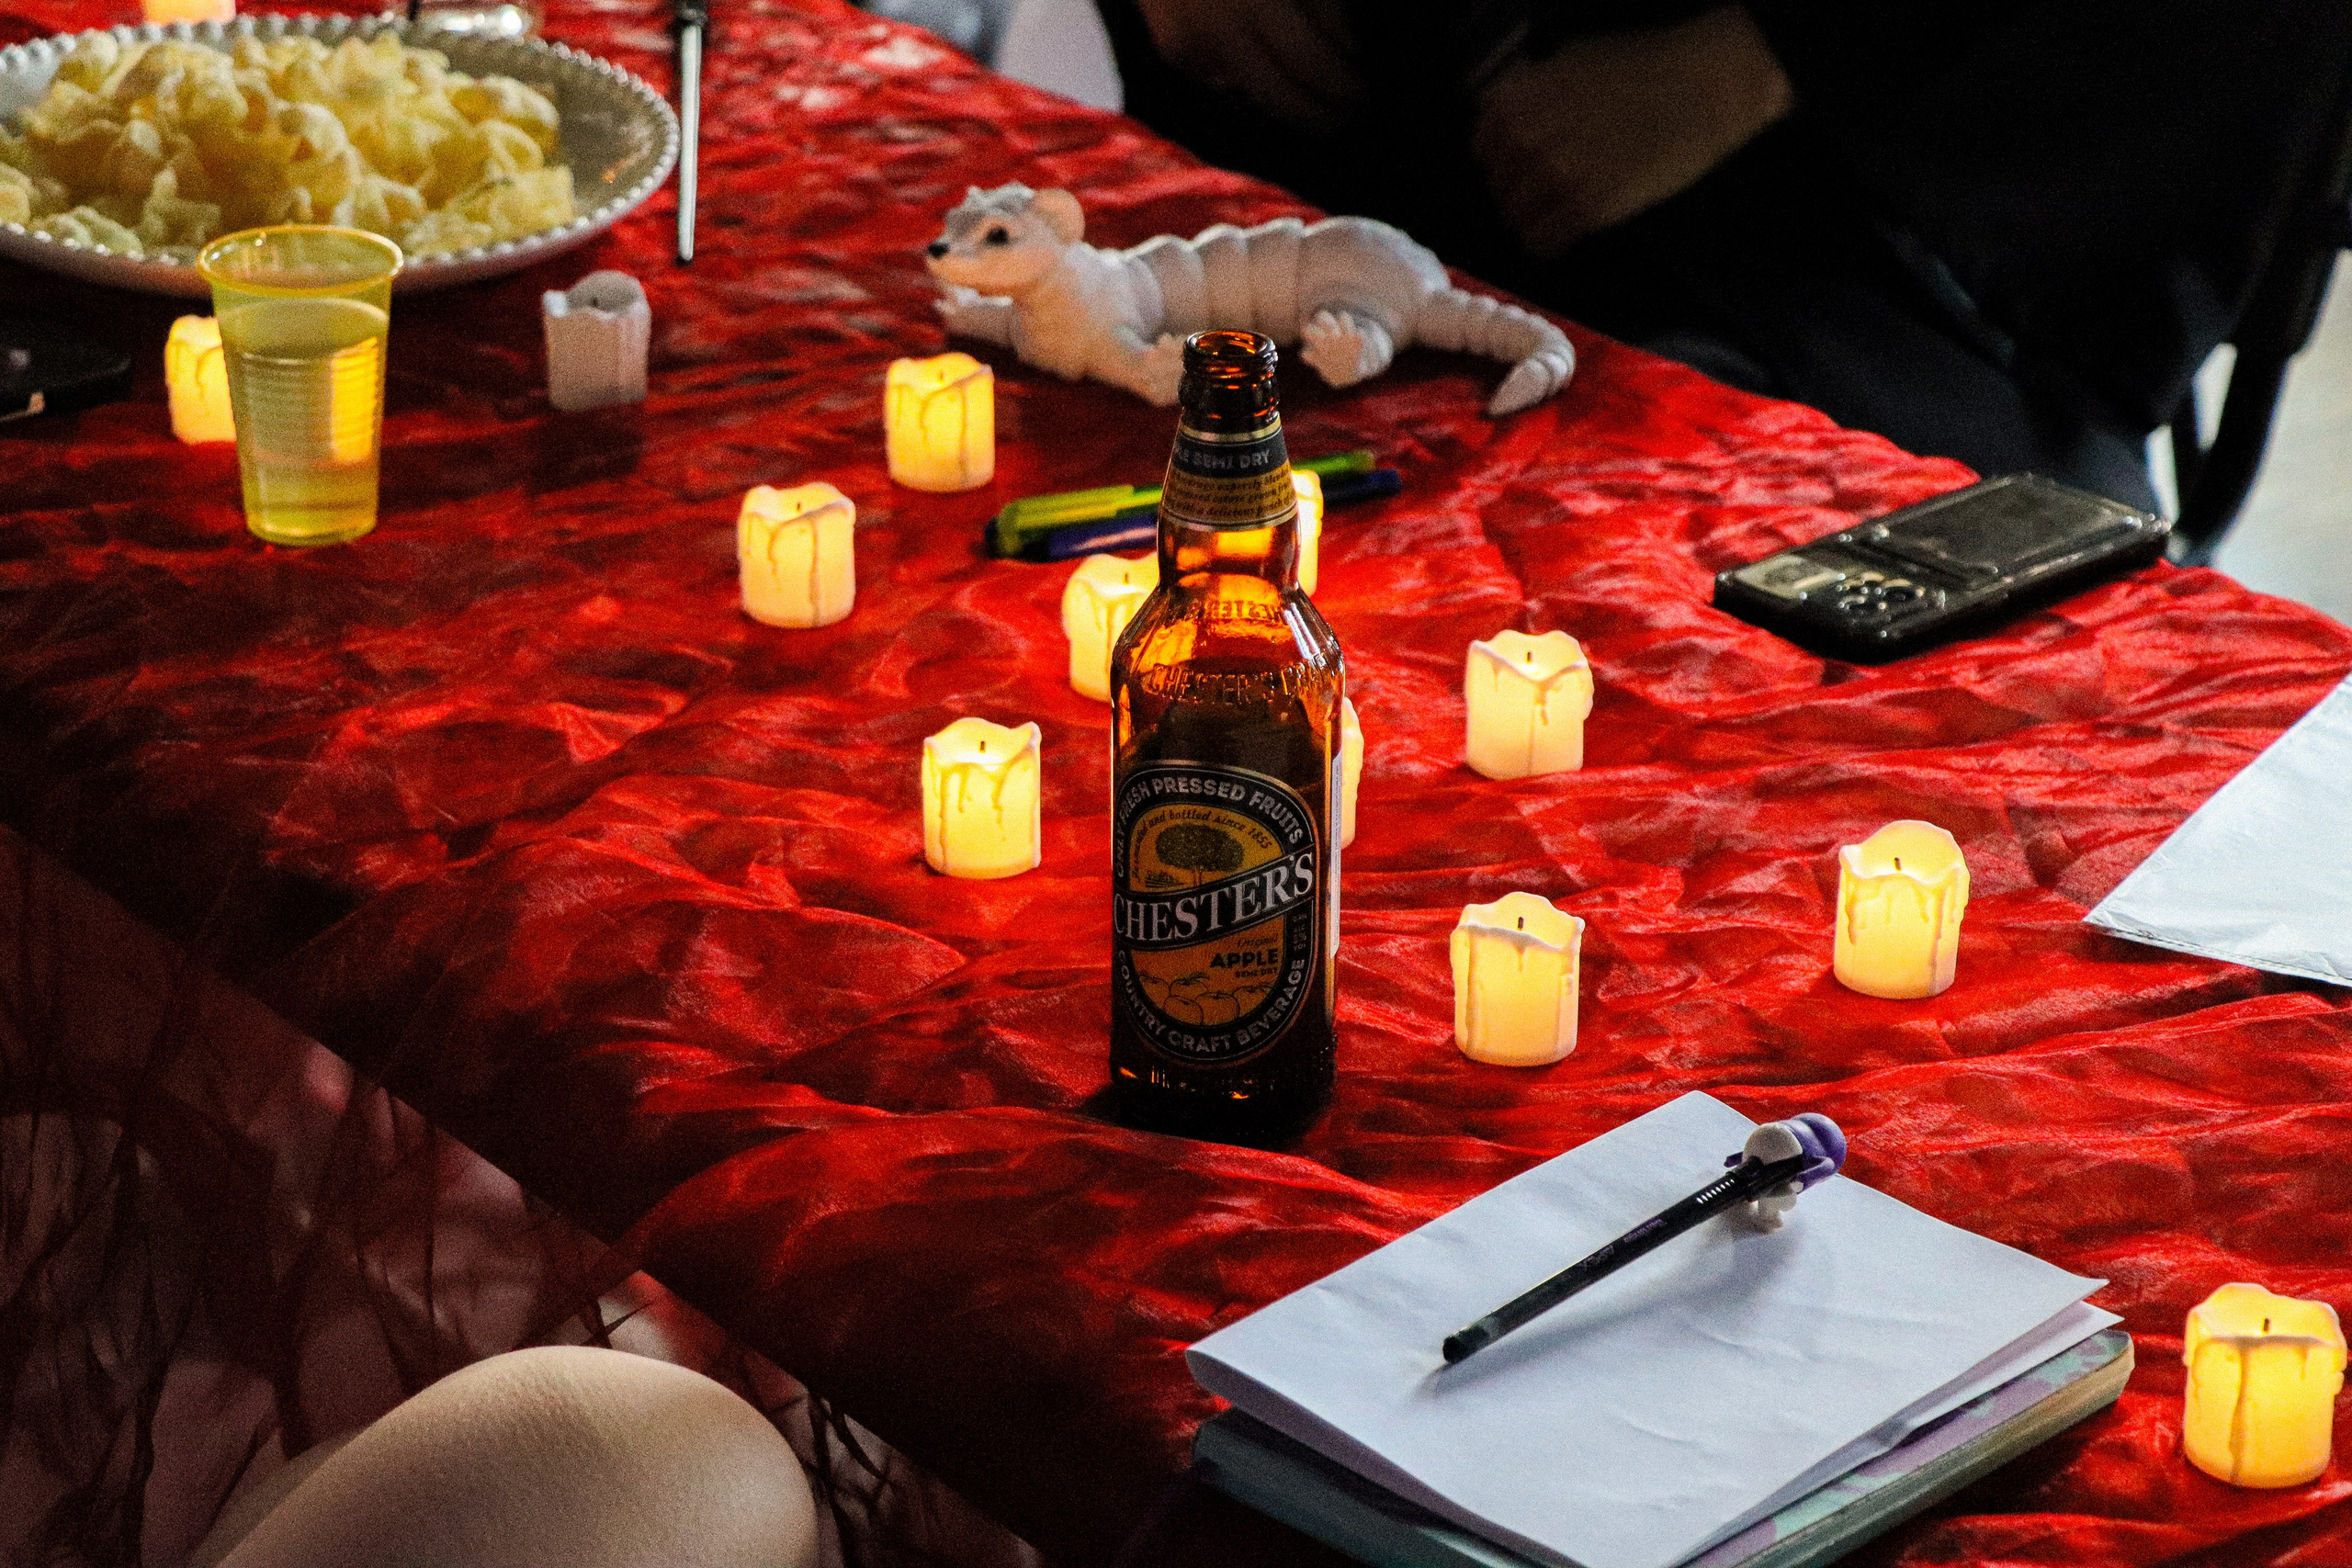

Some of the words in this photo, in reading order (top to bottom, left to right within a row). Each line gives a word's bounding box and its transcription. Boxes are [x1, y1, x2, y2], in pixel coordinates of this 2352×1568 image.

[1193, 452, 1233, 469] SEMI
[1240, 448, 1271, 468] DRY
[1118, 781, 1151, 825] FRESH
[1151, 776, 1246, 802] PRESSED
[1249, 791, 1305, 844] FRUITS
[1148, 811, 1166, 828] and
[1169, 808, 1213, 821] bottled
[1213, 814, 1247, 831] since
[1248, 826, 1273, 850] 1855
[1114, 852, 1314, 942] CHESTER'S
[1210, 948, 1279, 969] APPLE
[1118, 950, 1167, 1036] COUNTRY
[1168, 1030, 1231, 1053] CRAFT
[1238, 959, 1305, 1046] BEVERAGE
